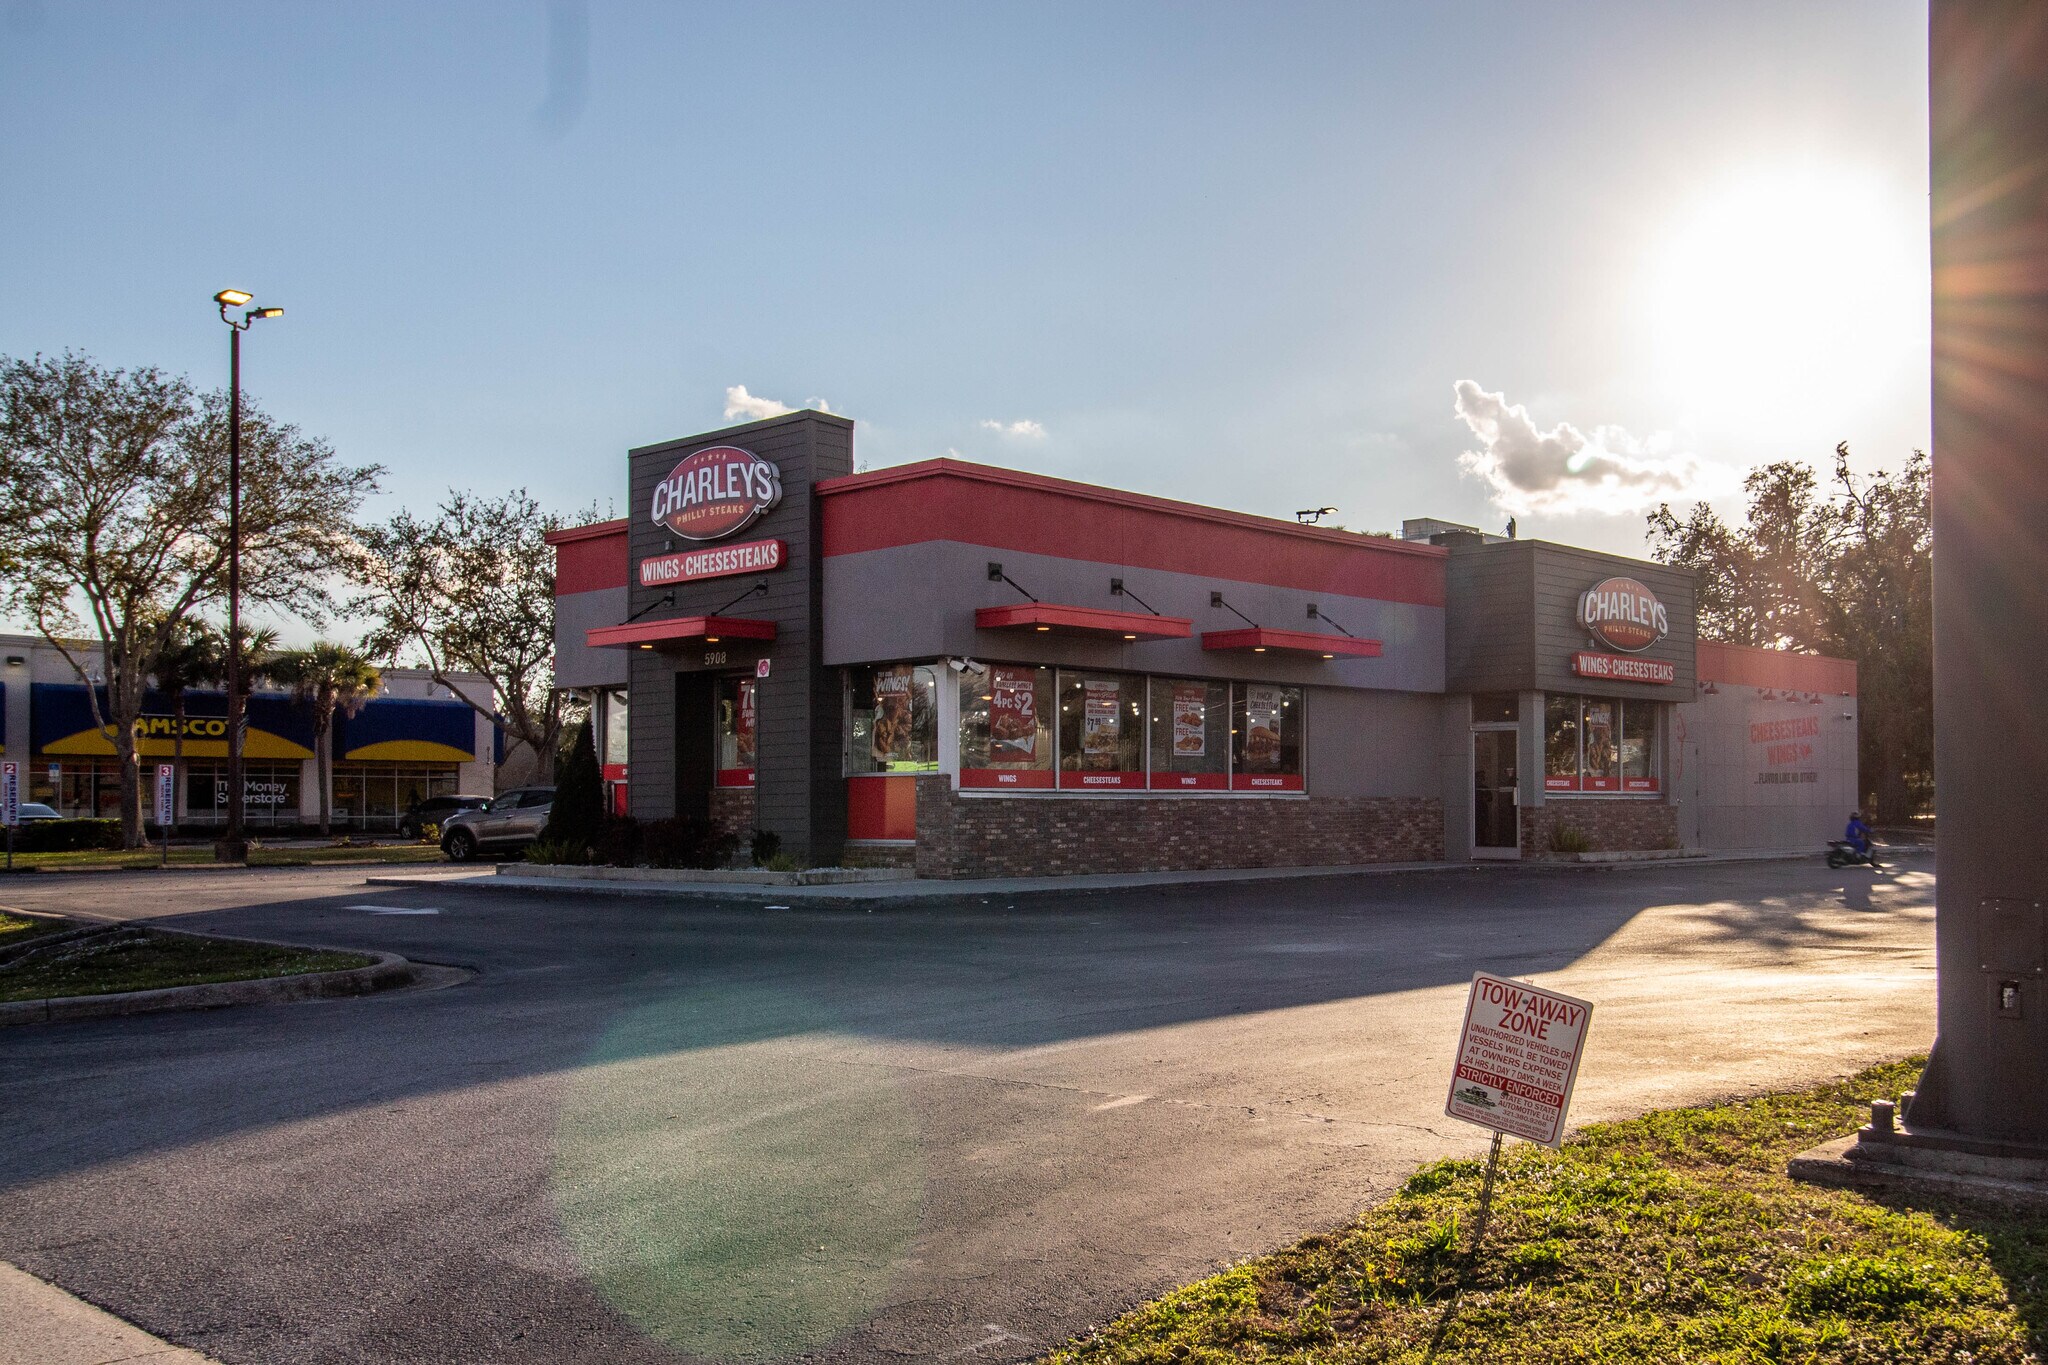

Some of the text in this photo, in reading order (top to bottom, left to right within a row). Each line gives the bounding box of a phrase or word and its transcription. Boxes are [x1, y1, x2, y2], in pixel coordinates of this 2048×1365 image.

[652, 462, 774, 521] CHARLEYS
[677, 504, 745, 525] PHILLY STEAKS
[642, 543, 778, 582] WINGS CHEESESTEAKS
[1585, 591, 1668, 634] CHARLEYS
[1604, 625, 1651, 638] PHILLY STEAKS
[704, 651, 727, 666] 5908
[1579, 655, 1674, 681] WINGS CHEESESTEAKS
[135, 717, 229, 736] AMSCO
[6, 764, 14, 774] 2
[162, 766, 170, 776] 3
[998, 774, 1017, 783] WINGS
[1083, 776, 1121, 784] CHEESESTEAKS
[1181, 777, 1197, 785] WINGS
[246, 781, 287, 793] Money
[1251, 778, 1283, 786] CHEESESTEAKS
[9, 774, 17, 821] RESERVED
[1525, 995, 1581, 1027] AWAY
[1498, 1008, 1550, 1041] ZONE
[1469, 1034, 1568, 1071] VESSELS WILL BE TOWED
[1470, 1023, 1572, 1060] UNAUTHORIZED VEHICLES OR
[1464, 1056, 1562, 1092] 24 HRS A DAY 7 DAYS A WEEK
[1469, 1046, 1563, 1081] AT OWNERS EXPENSE
[1459, 1066, 1505, 1089] STRICTLY
[1506, 1080, 1559, 1106] ENFORCED
[1498, 1100, 1542, 1119] AUTOMOTIVE
[1542, 1113, 1555, 1122] LLC
[1500, 1093, 1522, 1105] STATE
[1523, 1100, 1533, 1108] TO
[1534, 1103, 1557, 1116] STATE
[1456, 1107, 1474, 1117] TOWING
[1481, 1115, 1508, 1128] REGULATED
[1516, 1126, 1539, 1137] CHAPTER
